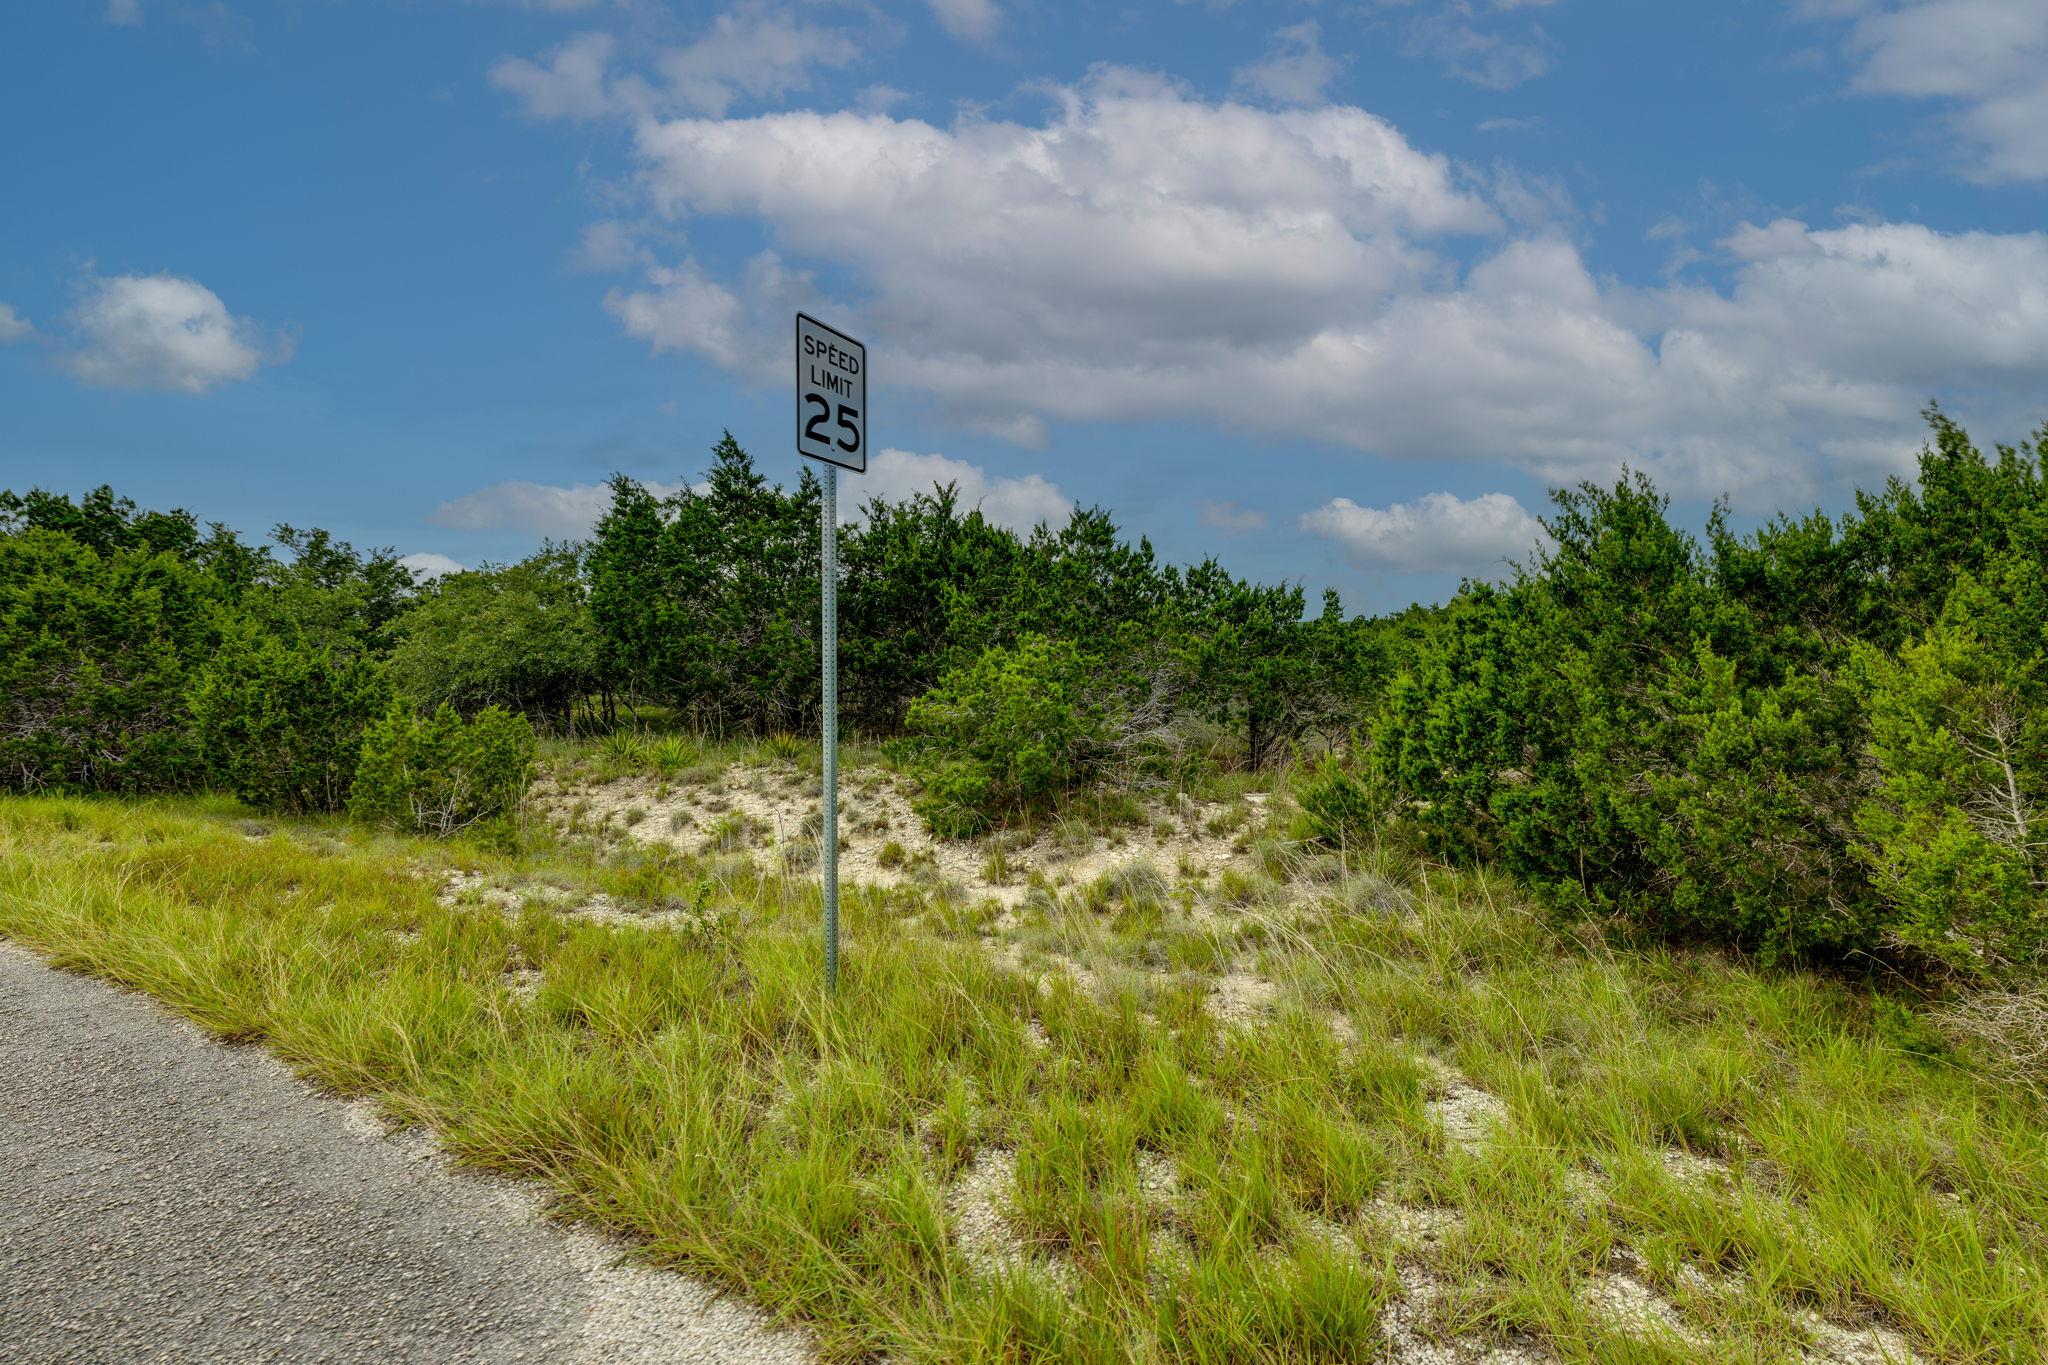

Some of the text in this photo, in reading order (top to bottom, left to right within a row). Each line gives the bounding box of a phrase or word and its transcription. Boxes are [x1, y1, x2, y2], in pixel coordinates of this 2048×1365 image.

[804, 335, 859, 375] SPEED
[811, 364, 853, 398] LIMIT
[804, 393, 860, 453] 25
